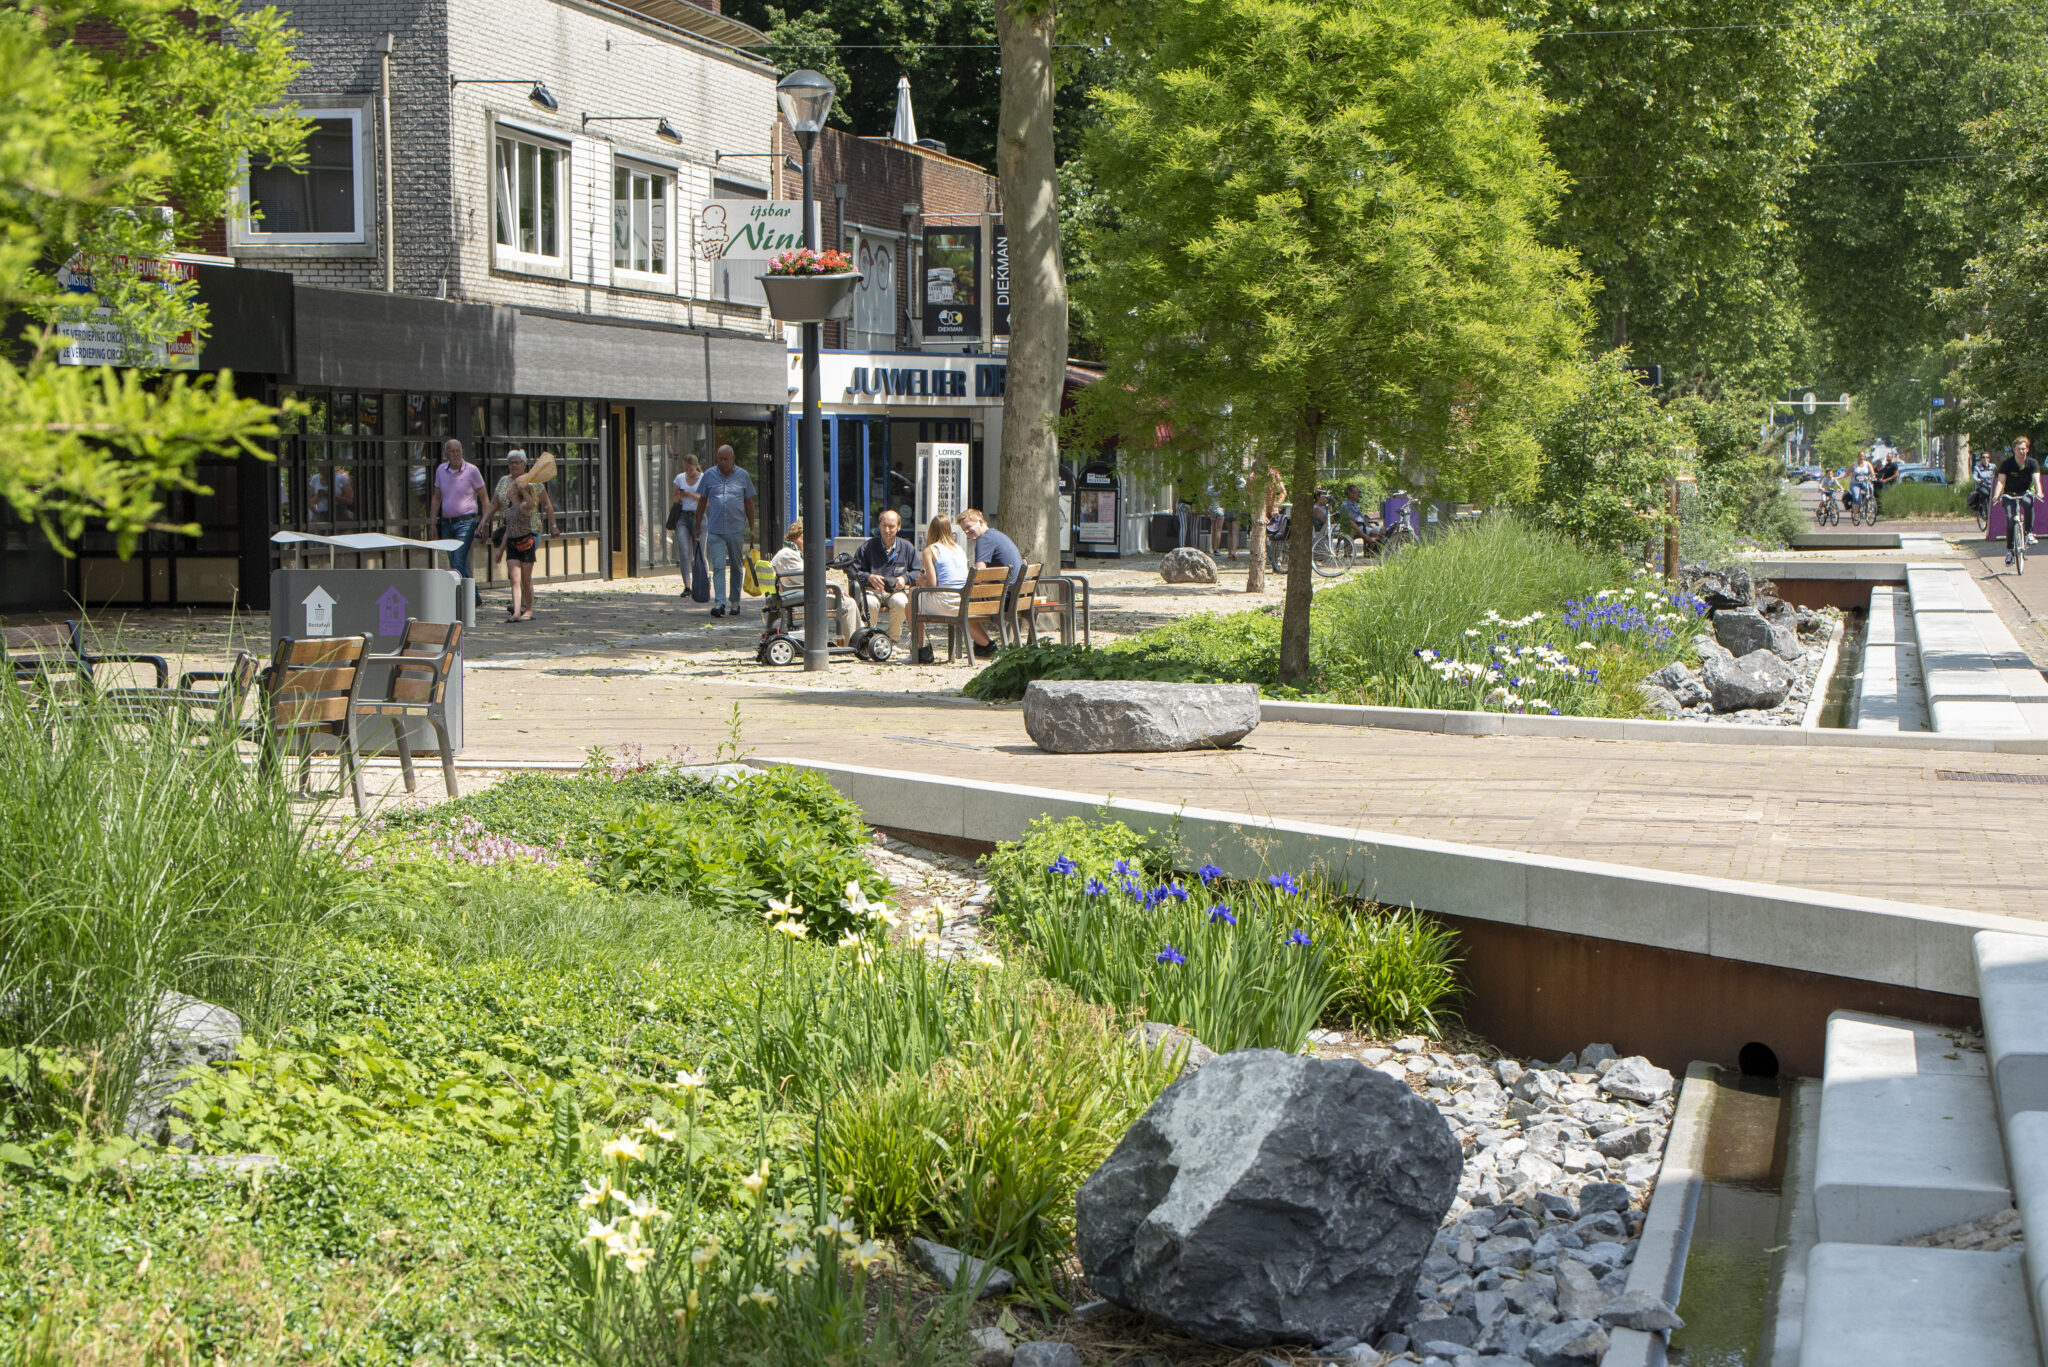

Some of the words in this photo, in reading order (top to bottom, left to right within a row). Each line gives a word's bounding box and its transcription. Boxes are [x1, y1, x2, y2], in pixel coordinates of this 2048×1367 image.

[750, 203, 791, 221] ijsbar
[997, 236, 1010, 306] DIEKMAN
[70, 329, 105, 342] VERDIEPING
[106, 331, 124, 343] CIRCA
[71, 347, 106, 360] VERDIEPING
[846, 366, 967, 397] JUWELIER
